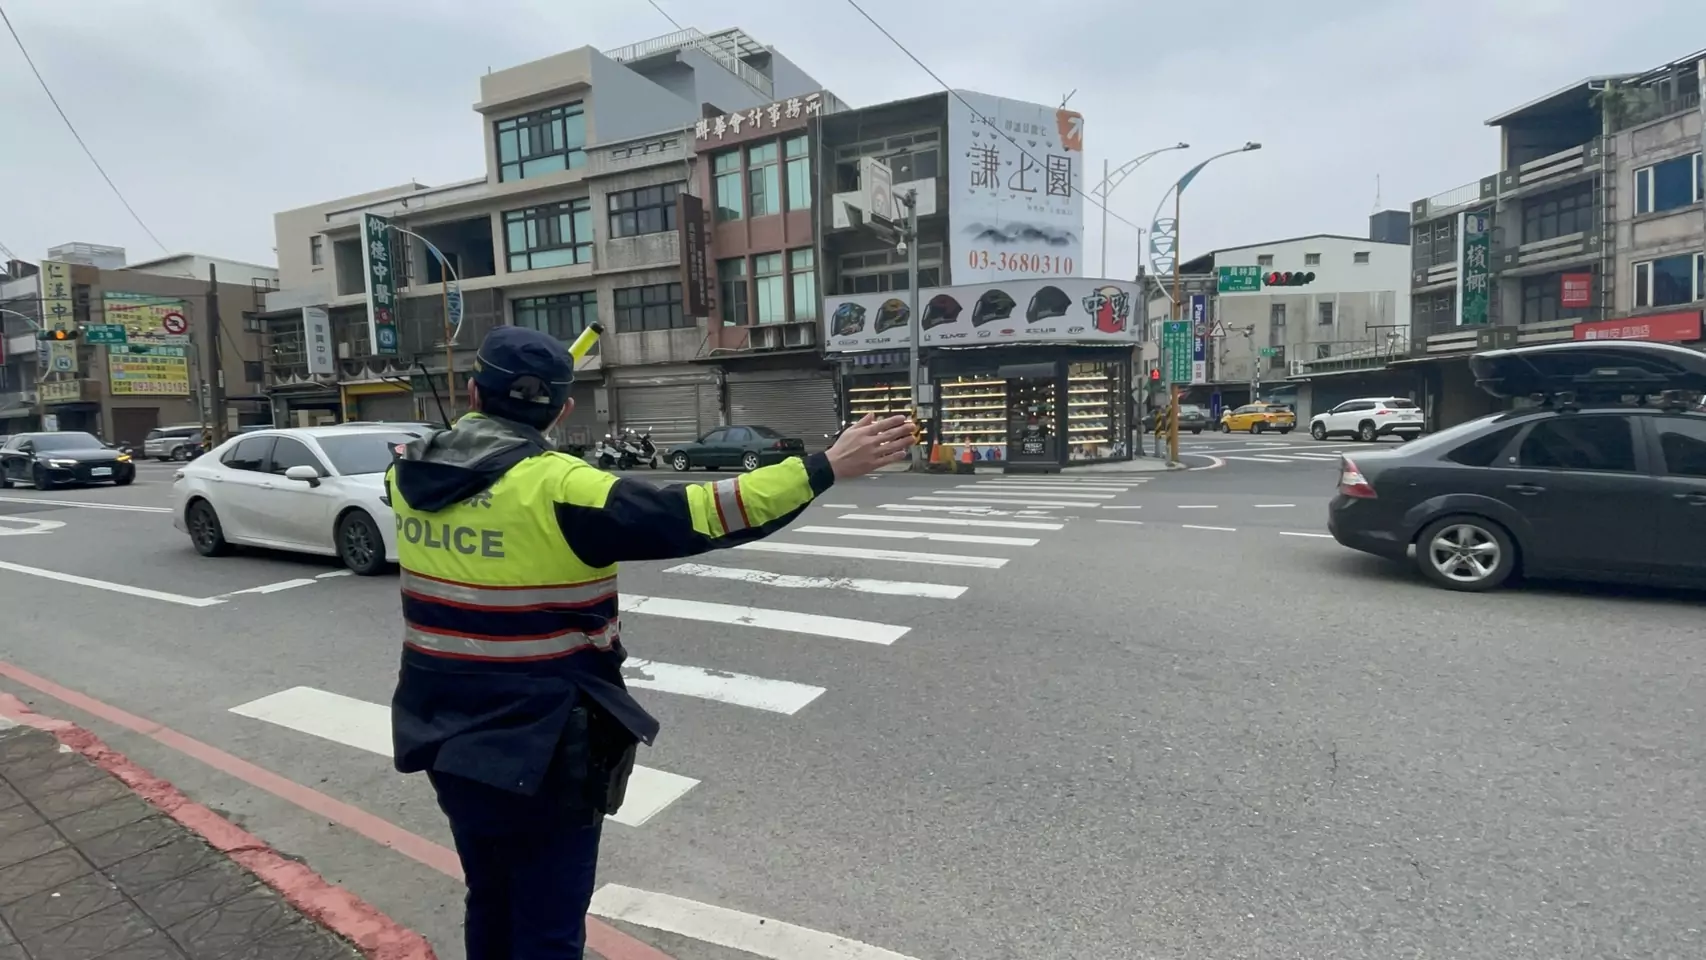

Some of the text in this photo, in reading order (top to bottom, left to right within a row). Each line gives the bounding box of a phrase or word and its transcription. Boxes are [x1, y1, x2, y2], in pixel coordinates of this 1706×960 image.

[369, 217, 391, 304] 仰德中醫
[969, 250, 1073, 275] 03-3680310
[1230, 267, 1257, 276] 員林路
[1465, 244, 1486, 293] 檳榔
